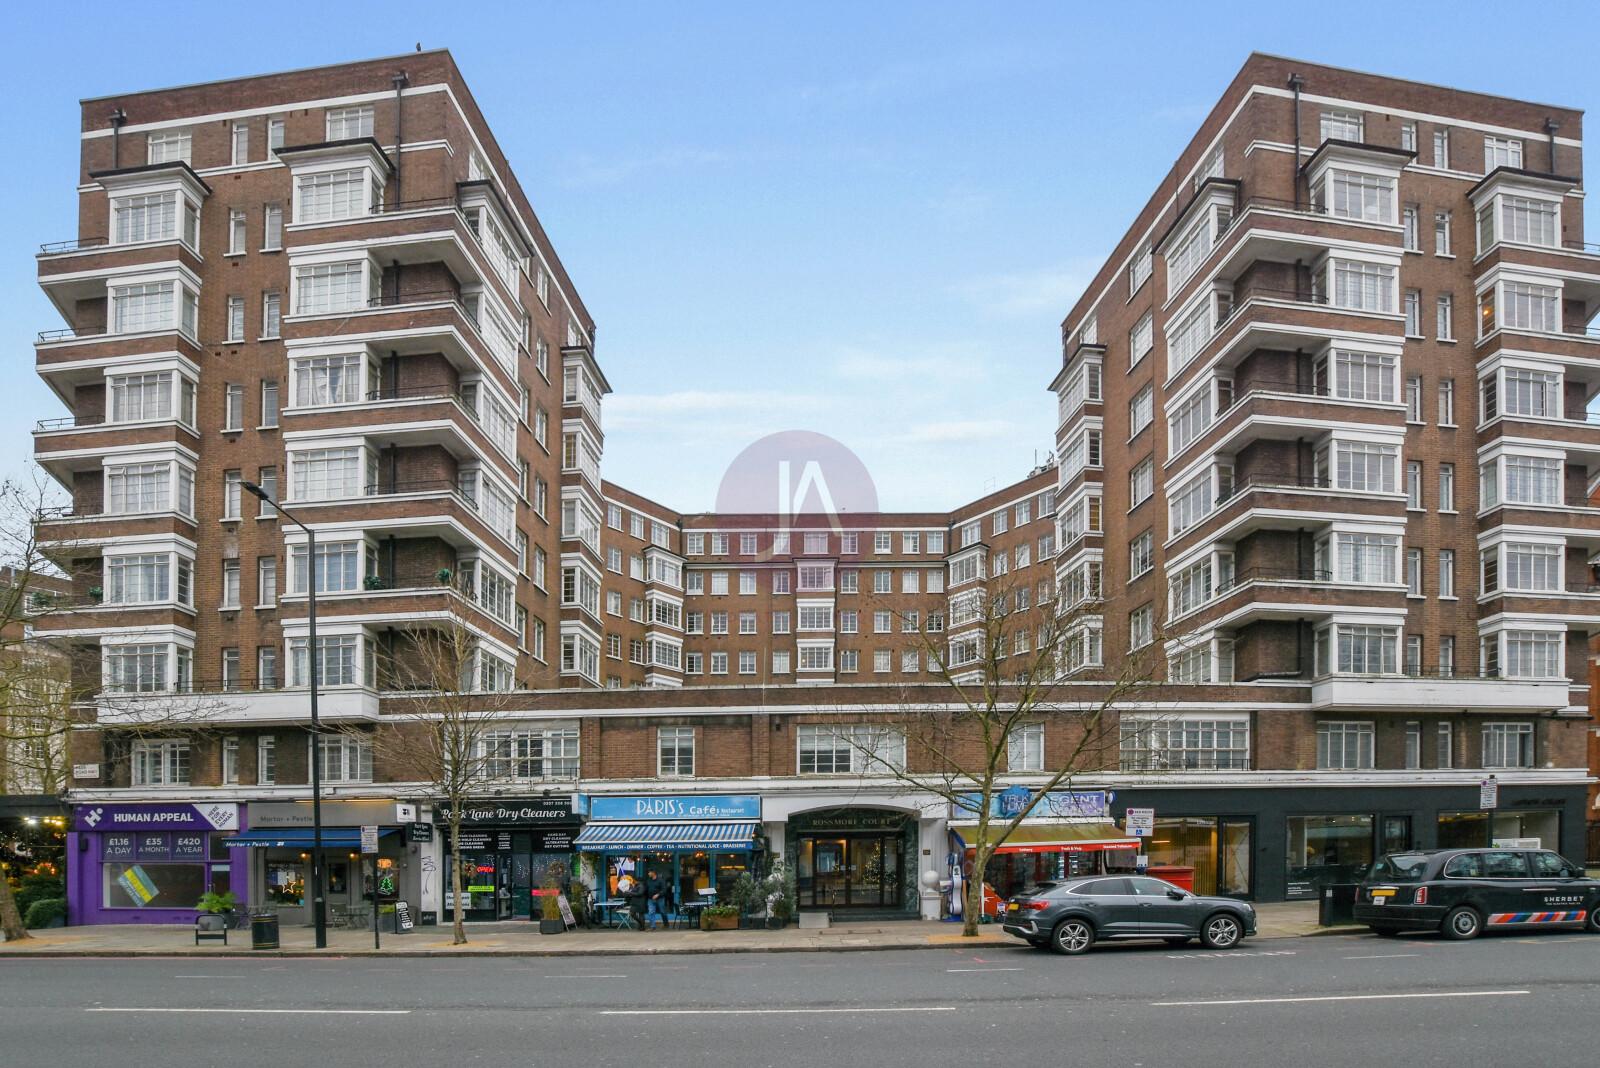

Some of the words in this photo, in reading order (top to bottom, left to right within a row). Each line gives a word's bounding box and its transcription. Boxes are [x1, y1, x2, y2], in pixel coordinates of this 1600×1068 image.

[1050, 795, 1099, 804] EGENT
[208, 805, 219, 817] HERE
[212, 812, 220, 820] FOR
[441, 808, 466, 819] Pak
[470, 809, 494, 820] Lane
[496, 808, 519, 820] Dry
[520, 808, 566, 818] Cleaners
[114, 814, 150, 822] HUMAN
[152, 813, 194, 821] APPEAL
[214, 811, 227, 824] EVERY
[218, 812, 233, 827] HUMAN
